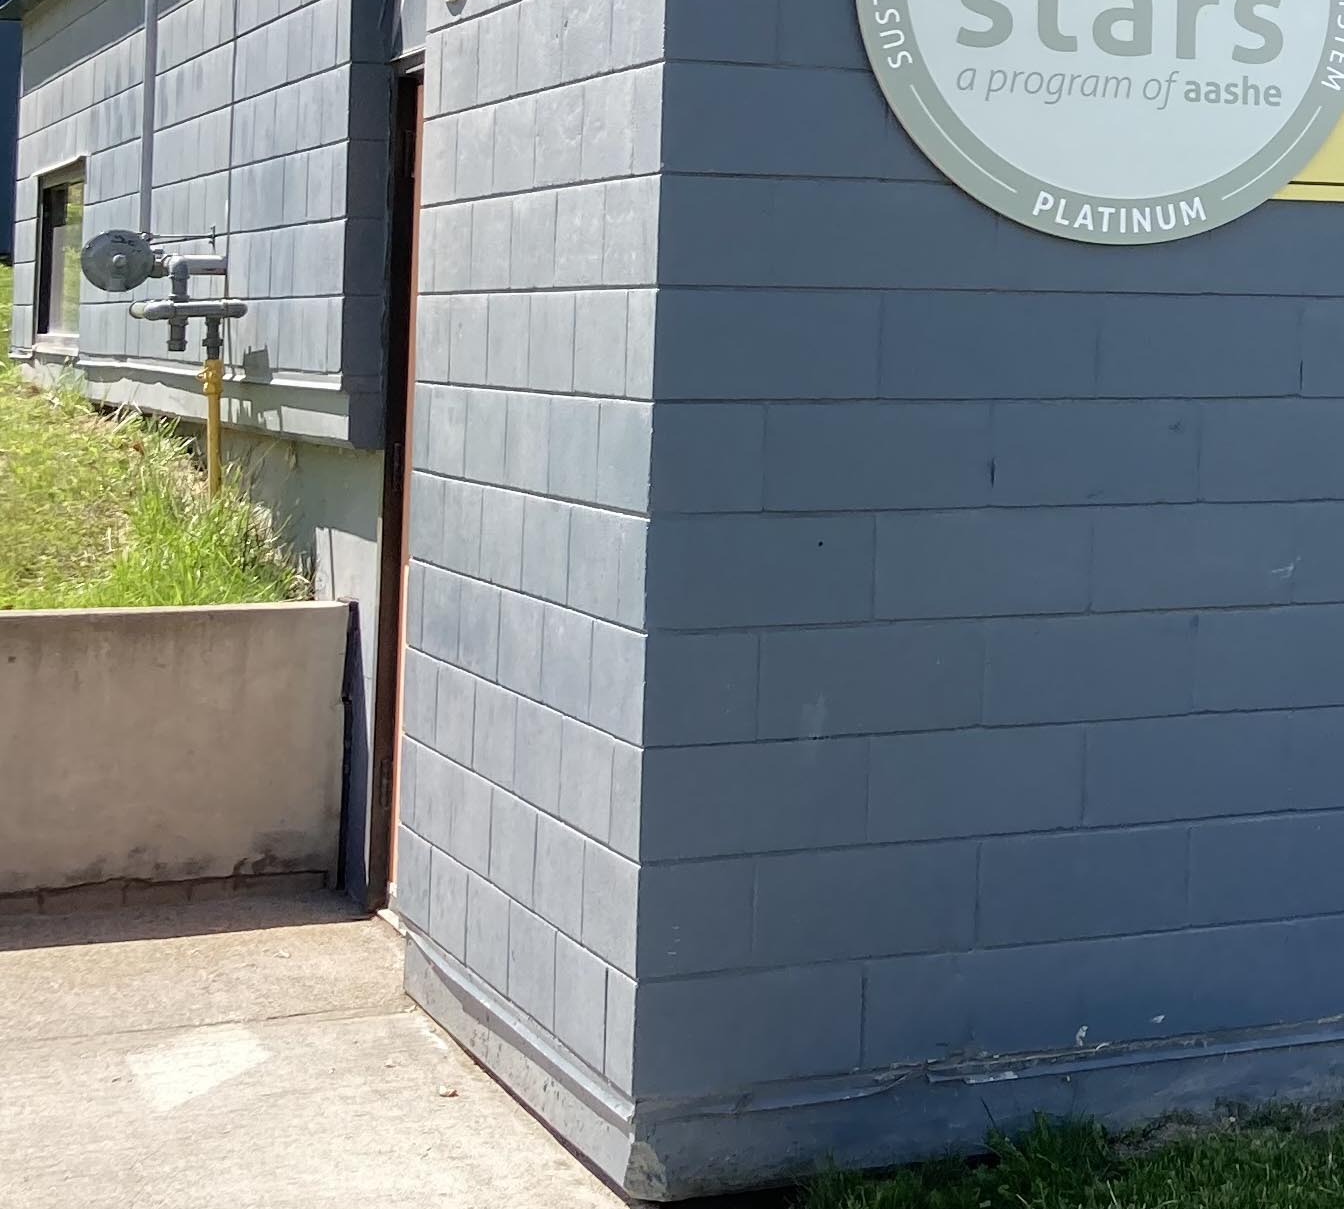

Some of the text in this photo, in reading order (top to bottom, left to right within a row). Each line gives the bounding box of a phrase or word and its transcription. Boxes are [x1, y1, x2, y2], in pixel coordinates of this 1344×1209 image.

[956, 68, 1282, 110] a program of aashe
[1032, 191, 1207, 233] PLATINUM
